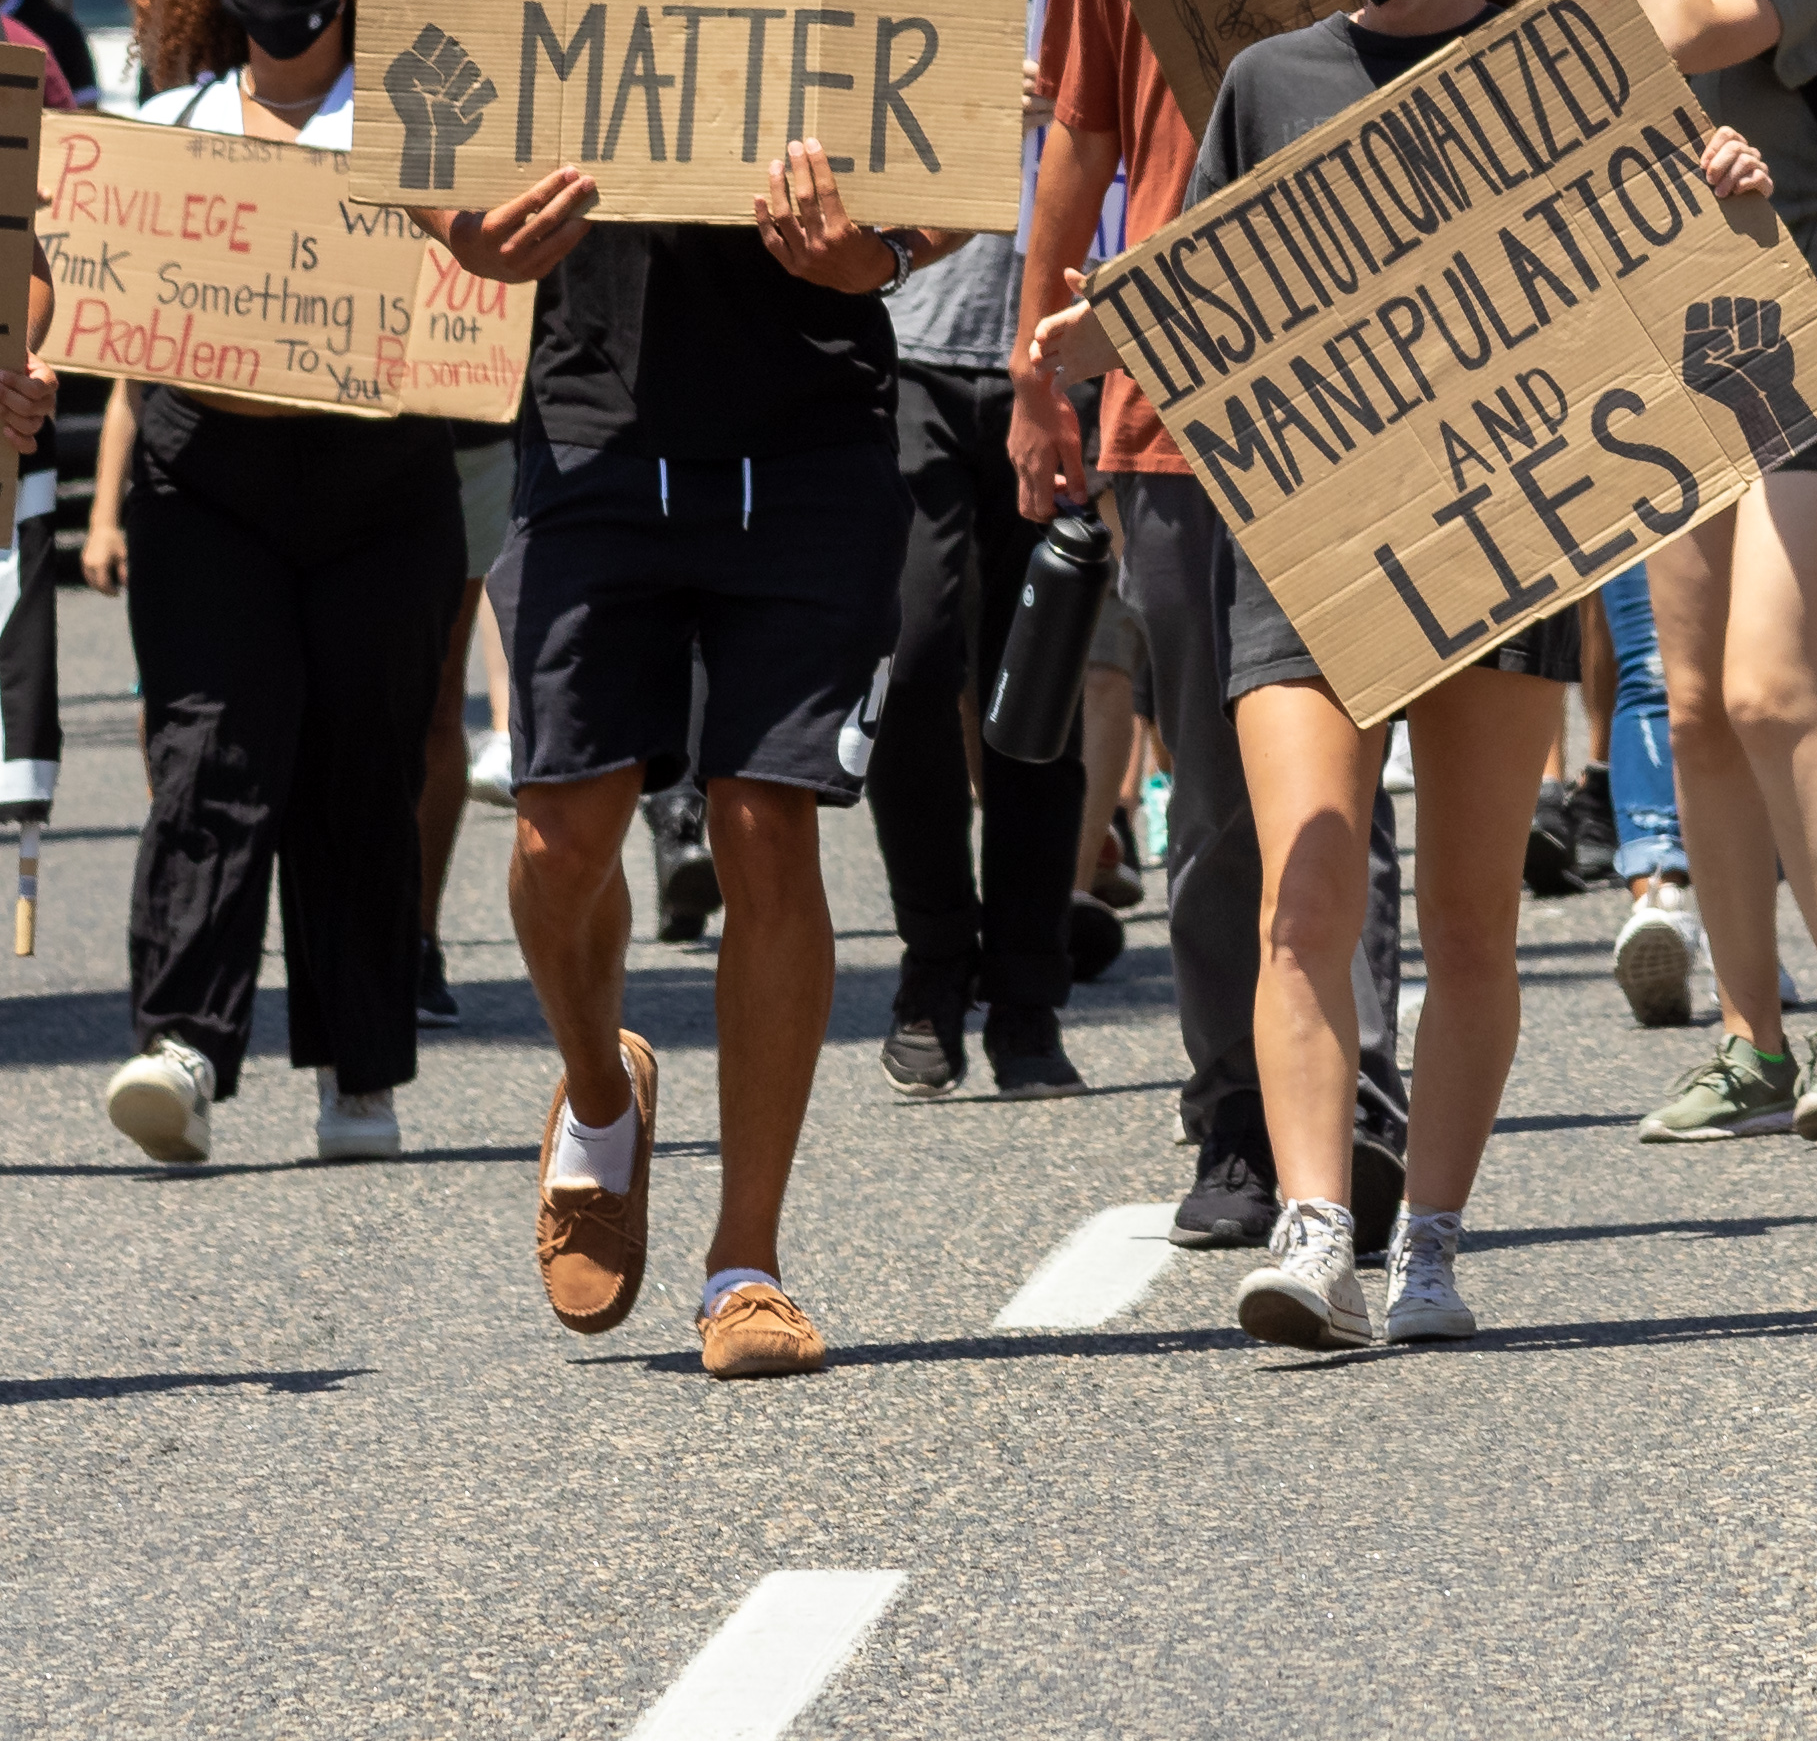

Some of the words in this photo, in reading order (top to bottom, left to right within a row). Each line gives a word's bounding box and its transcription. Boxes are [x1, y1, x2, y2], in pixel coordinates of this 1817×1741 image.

[514, 0, 943, 175] MATTER
[156, 261, 354, 355] Something
[429, 308, 483, 345] not
[374, 334, 524, 395] Personally
[1180, 105, 1708, 525] MANIPULATION
[1436, 365, 1569, 494] AND
[1373, 386, 1703, 662] LIES
